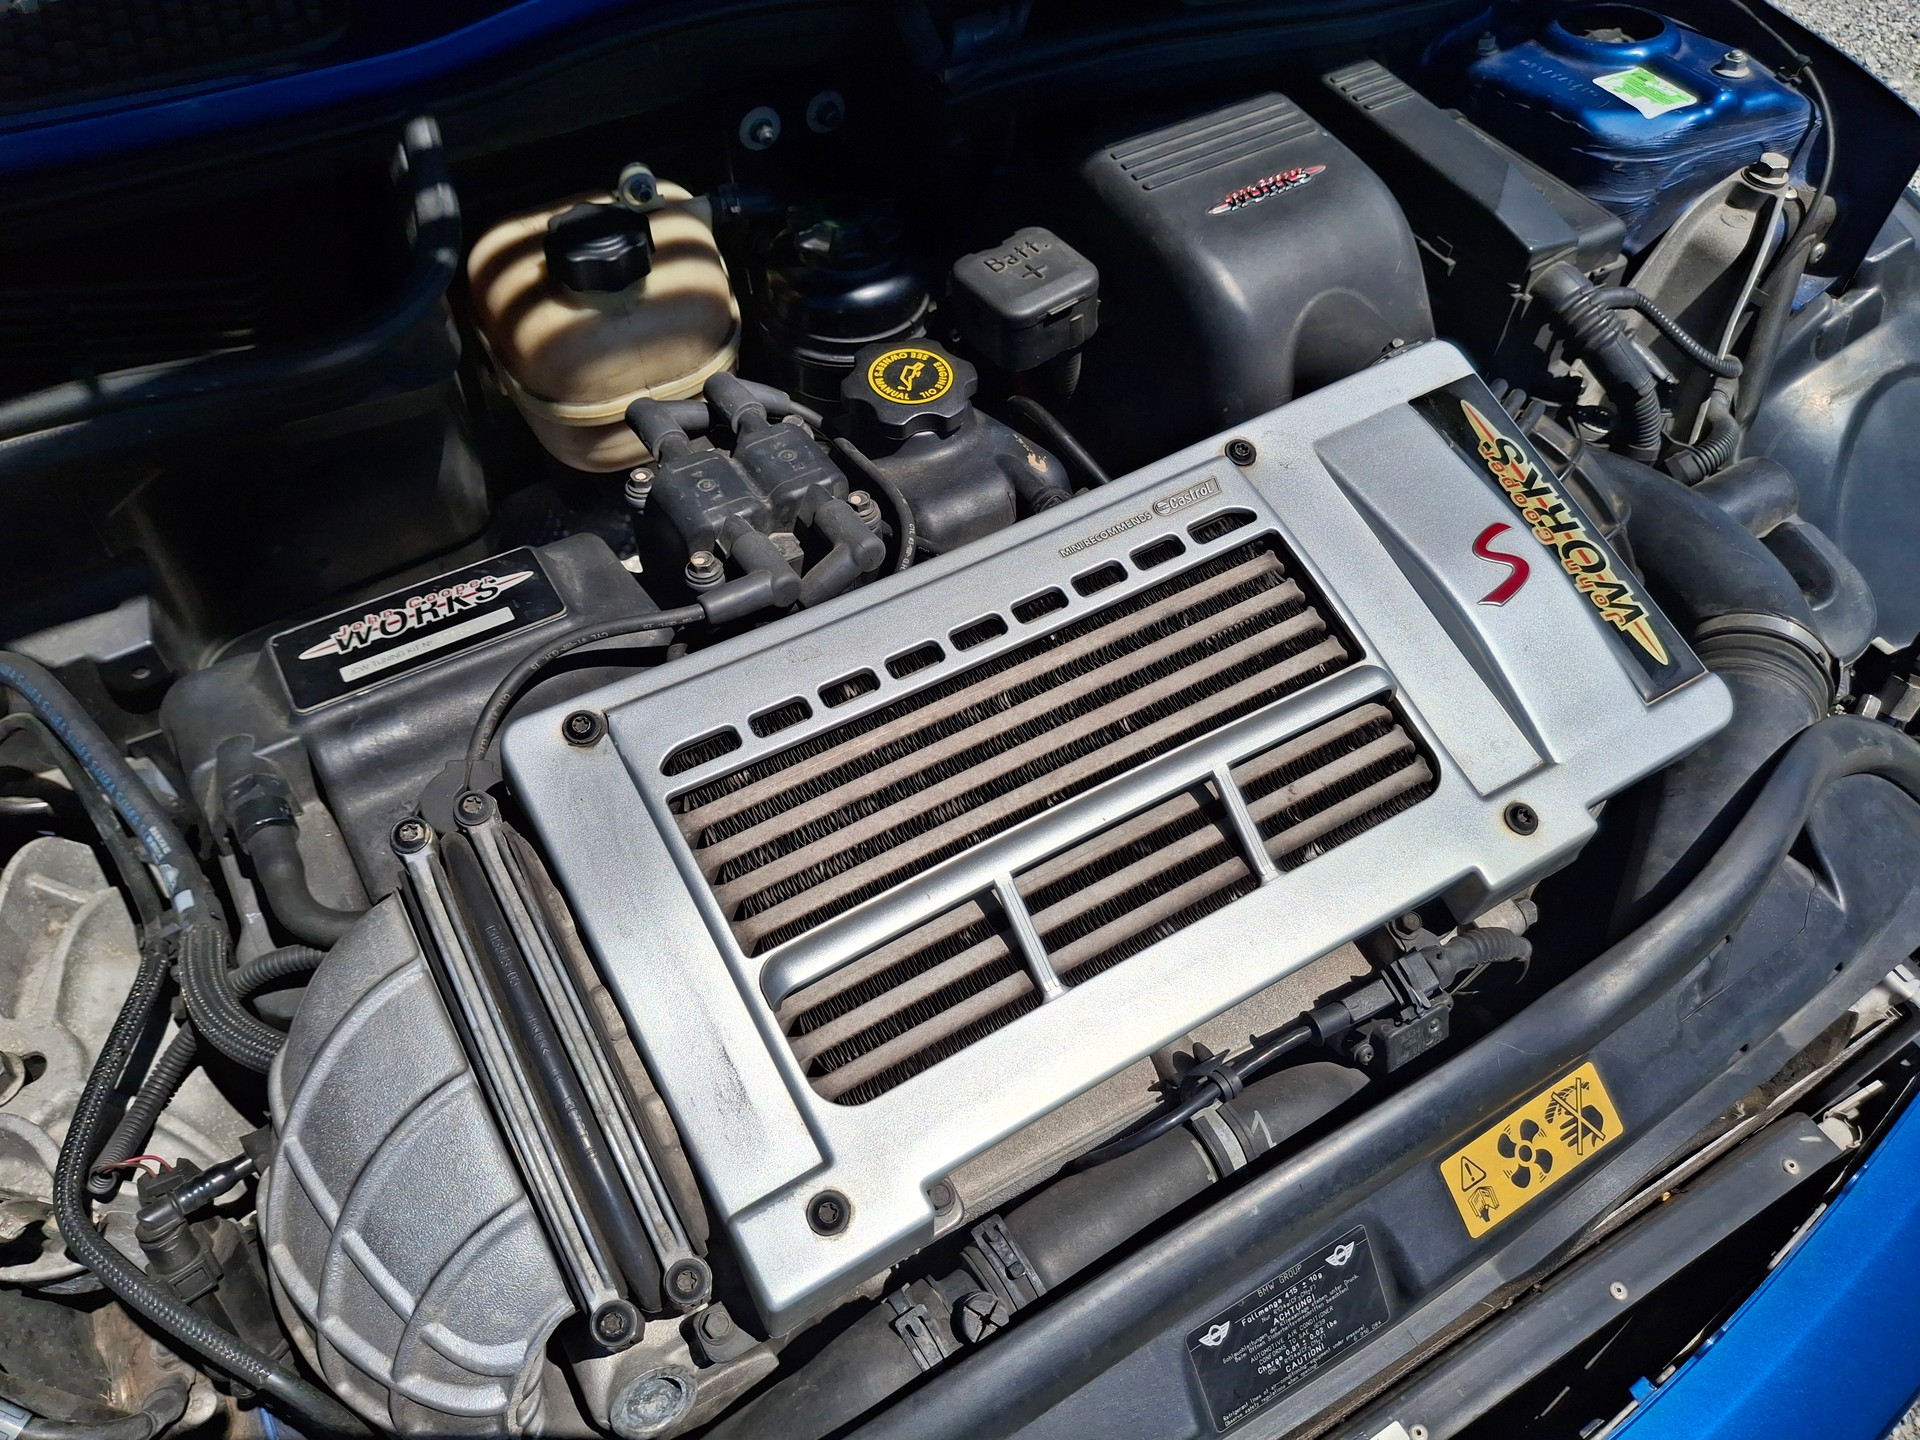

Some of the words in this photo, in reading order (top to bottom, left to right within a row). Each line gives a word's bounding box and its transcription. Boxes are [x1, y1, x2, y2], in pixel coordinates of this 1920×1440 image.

[983, 241, 1048, 273] Batt.
[910, 352, 930, 361] SEE
[874, 378, 910, 400] MANUAL
[919, 388, 937, 399] OIL
[933, 361, 949, 390] ENGINE
[1480, 446, 1555, 543] Cooper
[1059, 543, 1083, 558] MINI
[1085, 511, 1152, 548] RECOMMENDS
[1169, 481, 1213, 509] Castrol
[1493, 438, 1645, 627] WORKS
[1472, 522, 1530, 607] S
[336, 609, 393, 637] John
[408, 576, 492, 608] Cooper
[1562, 558, 1626, 626] John
[335, 579, 499, 653] WORKS
[1257, 1282, 1275, 1297] BMW
[1279, 1264, 1302, 1284] GROUP
[1285, 1287, 1297, 1298] 415
[1273, 1293, 1315, 1326] ACHTUNG!
[1251, 1337, 1285, 1363] AUTOMOTIVE
[1288, 1329, 1297, 1339] AIR
[1300, 1305, 1334, 1330] CONDITIONER
[1258, 1356, 1283, 1374] Charge
[1310, 1327, 1324, 1339] 0.02
[1259, 1344, 1287, 1365] CONFORMS
[1298, 1329, 1309, 1339] SAE
[1285, 1343, 1325, 1373] CAUTION!
